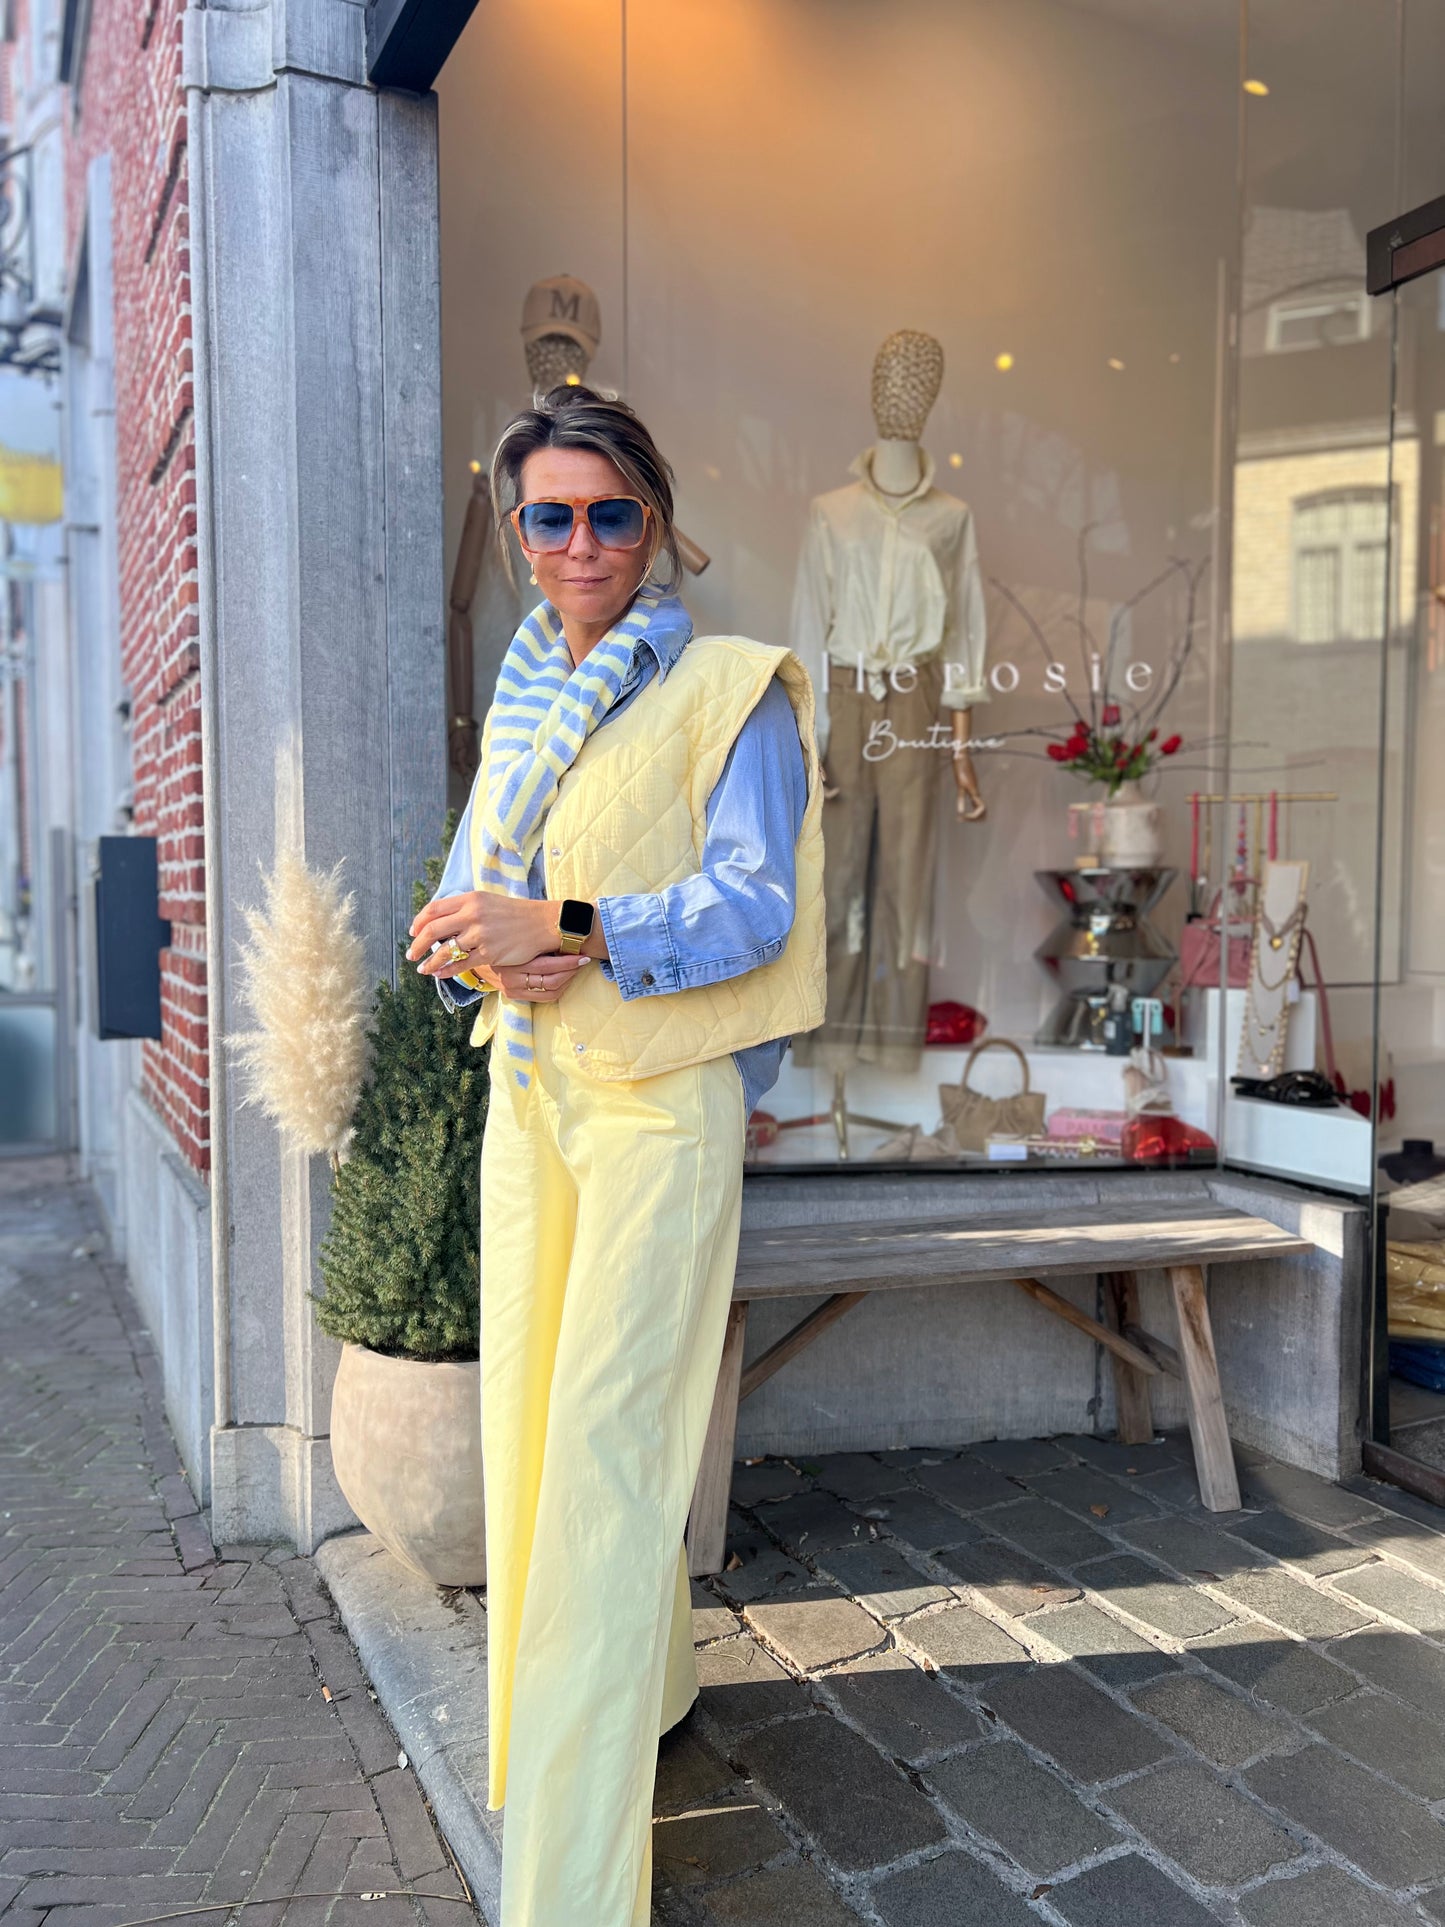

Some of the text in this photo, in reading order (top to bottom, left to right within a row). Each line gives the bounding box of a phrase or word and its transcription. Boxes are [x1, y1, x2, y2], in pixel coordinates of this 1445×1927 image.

[549, 289, 582, 322] M
[821, 651, 1153, 693] llerosie
[862, 719, 1005, 762] Boutique
